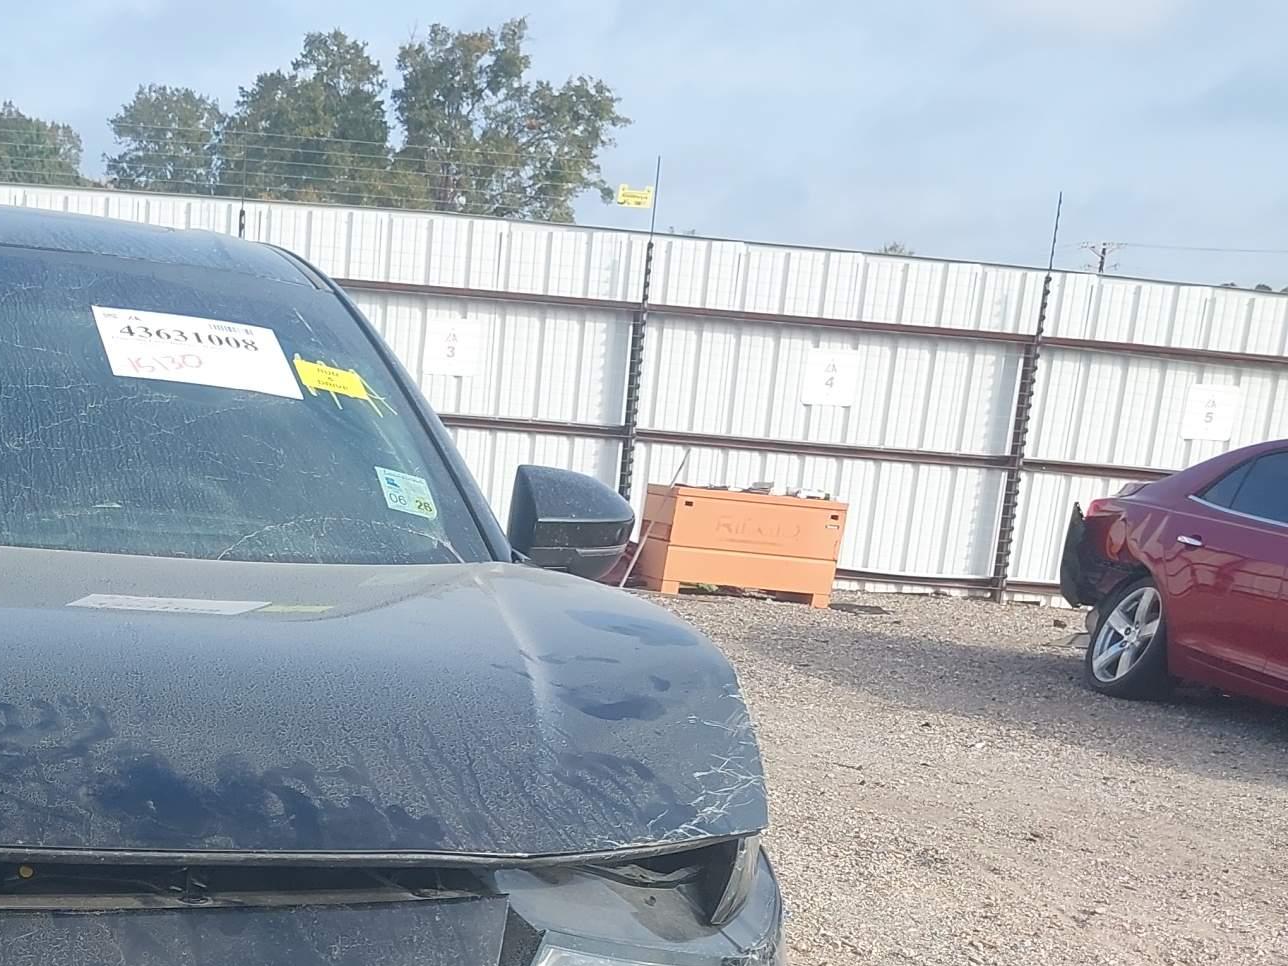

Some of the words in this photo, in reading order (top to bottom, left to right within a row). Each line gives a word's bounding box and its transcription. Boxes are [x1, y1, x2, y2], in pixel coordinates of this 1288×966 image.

[119, 324, 259, 352] 43631008
[446, 345, 456, 358] 3
[1204, 411, 1214, 424] 5
[389, 493, 408, 506] 06
[415, 499, 433, 512] 26
